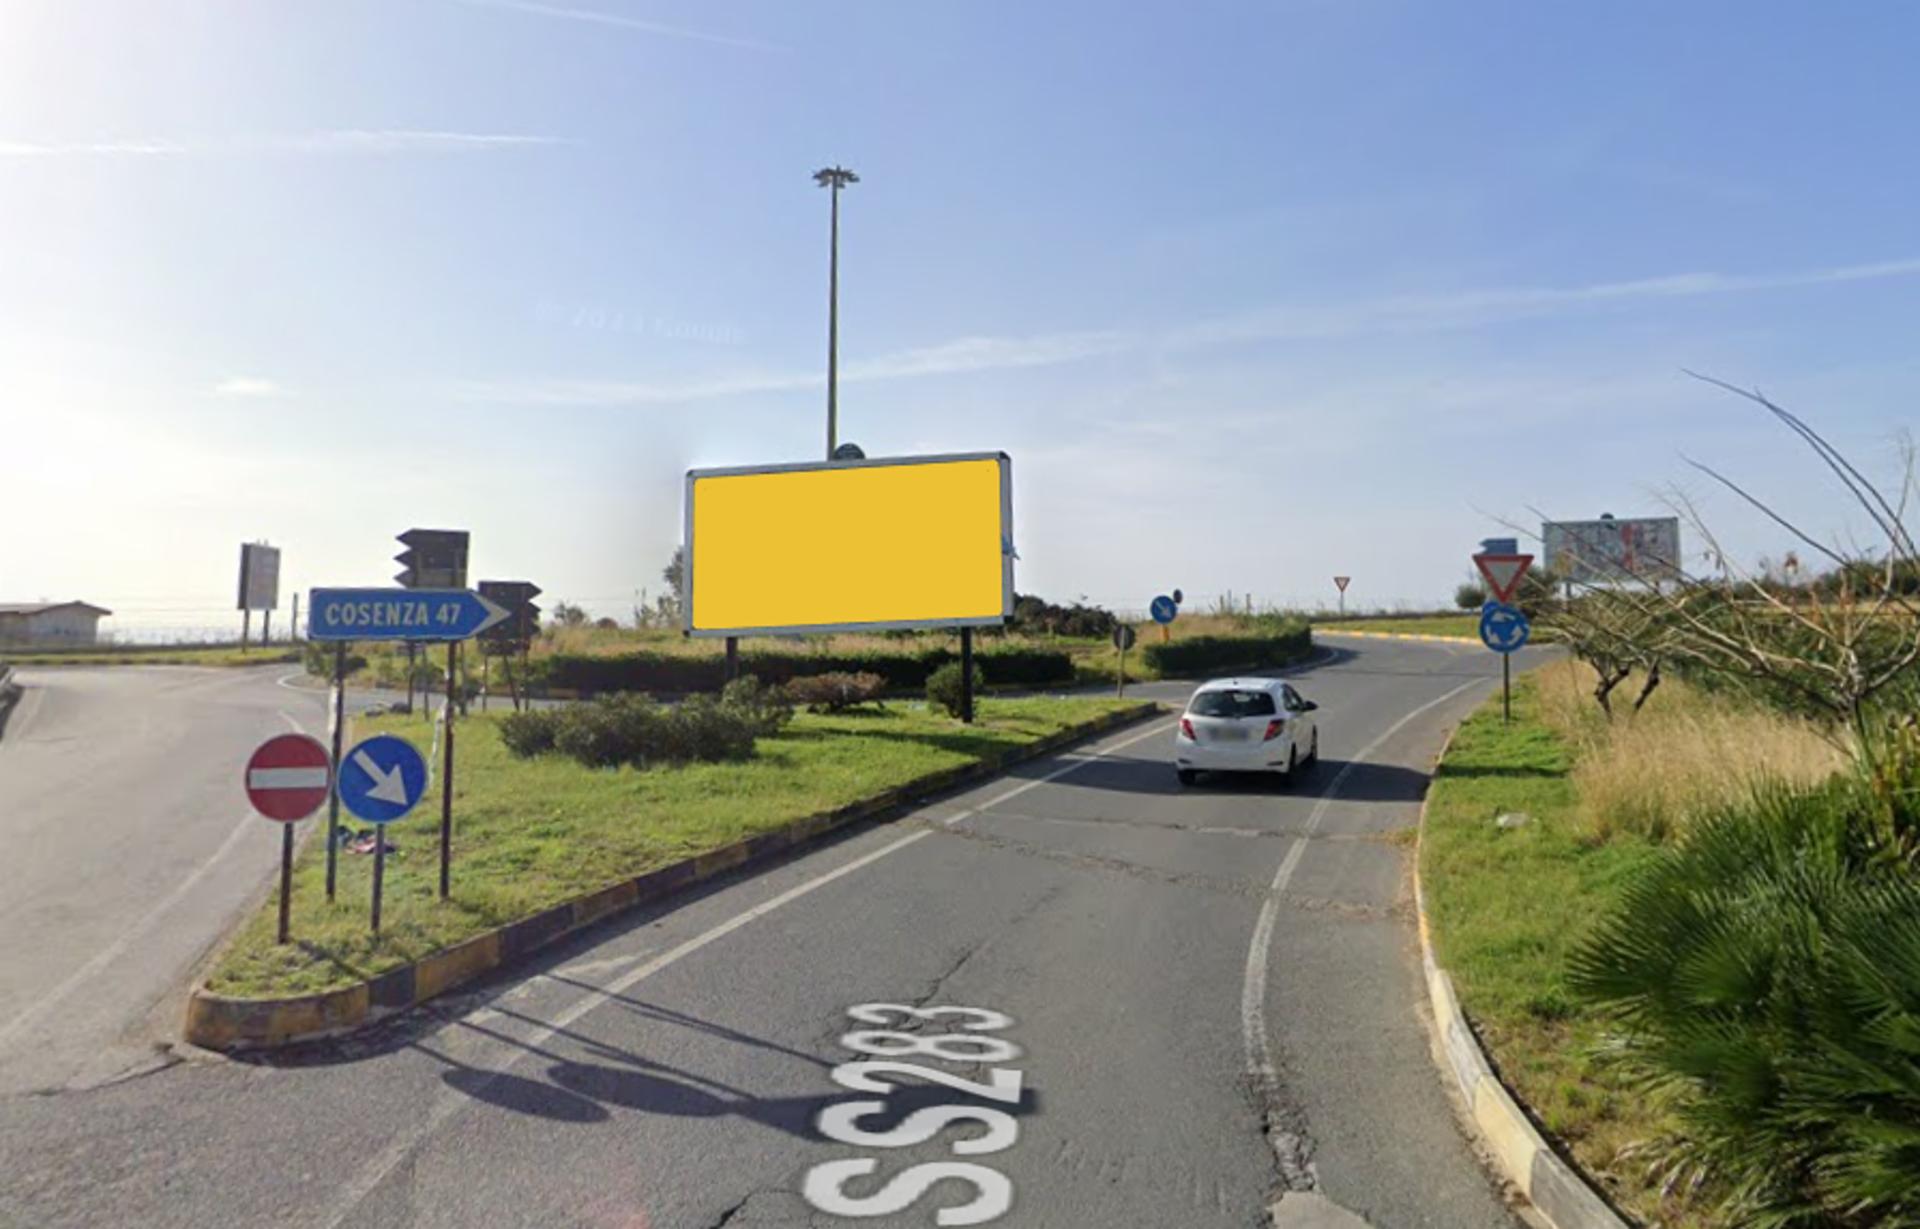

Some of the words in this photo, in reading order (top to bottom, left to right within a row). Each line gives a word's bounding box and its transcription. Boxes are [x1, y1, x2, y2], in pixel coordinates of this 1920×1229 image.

[325, 602, 428, 627] COSENZA
[436, 603, 461, 625] 47
[803, 1003, 1023, 1226] SS283
